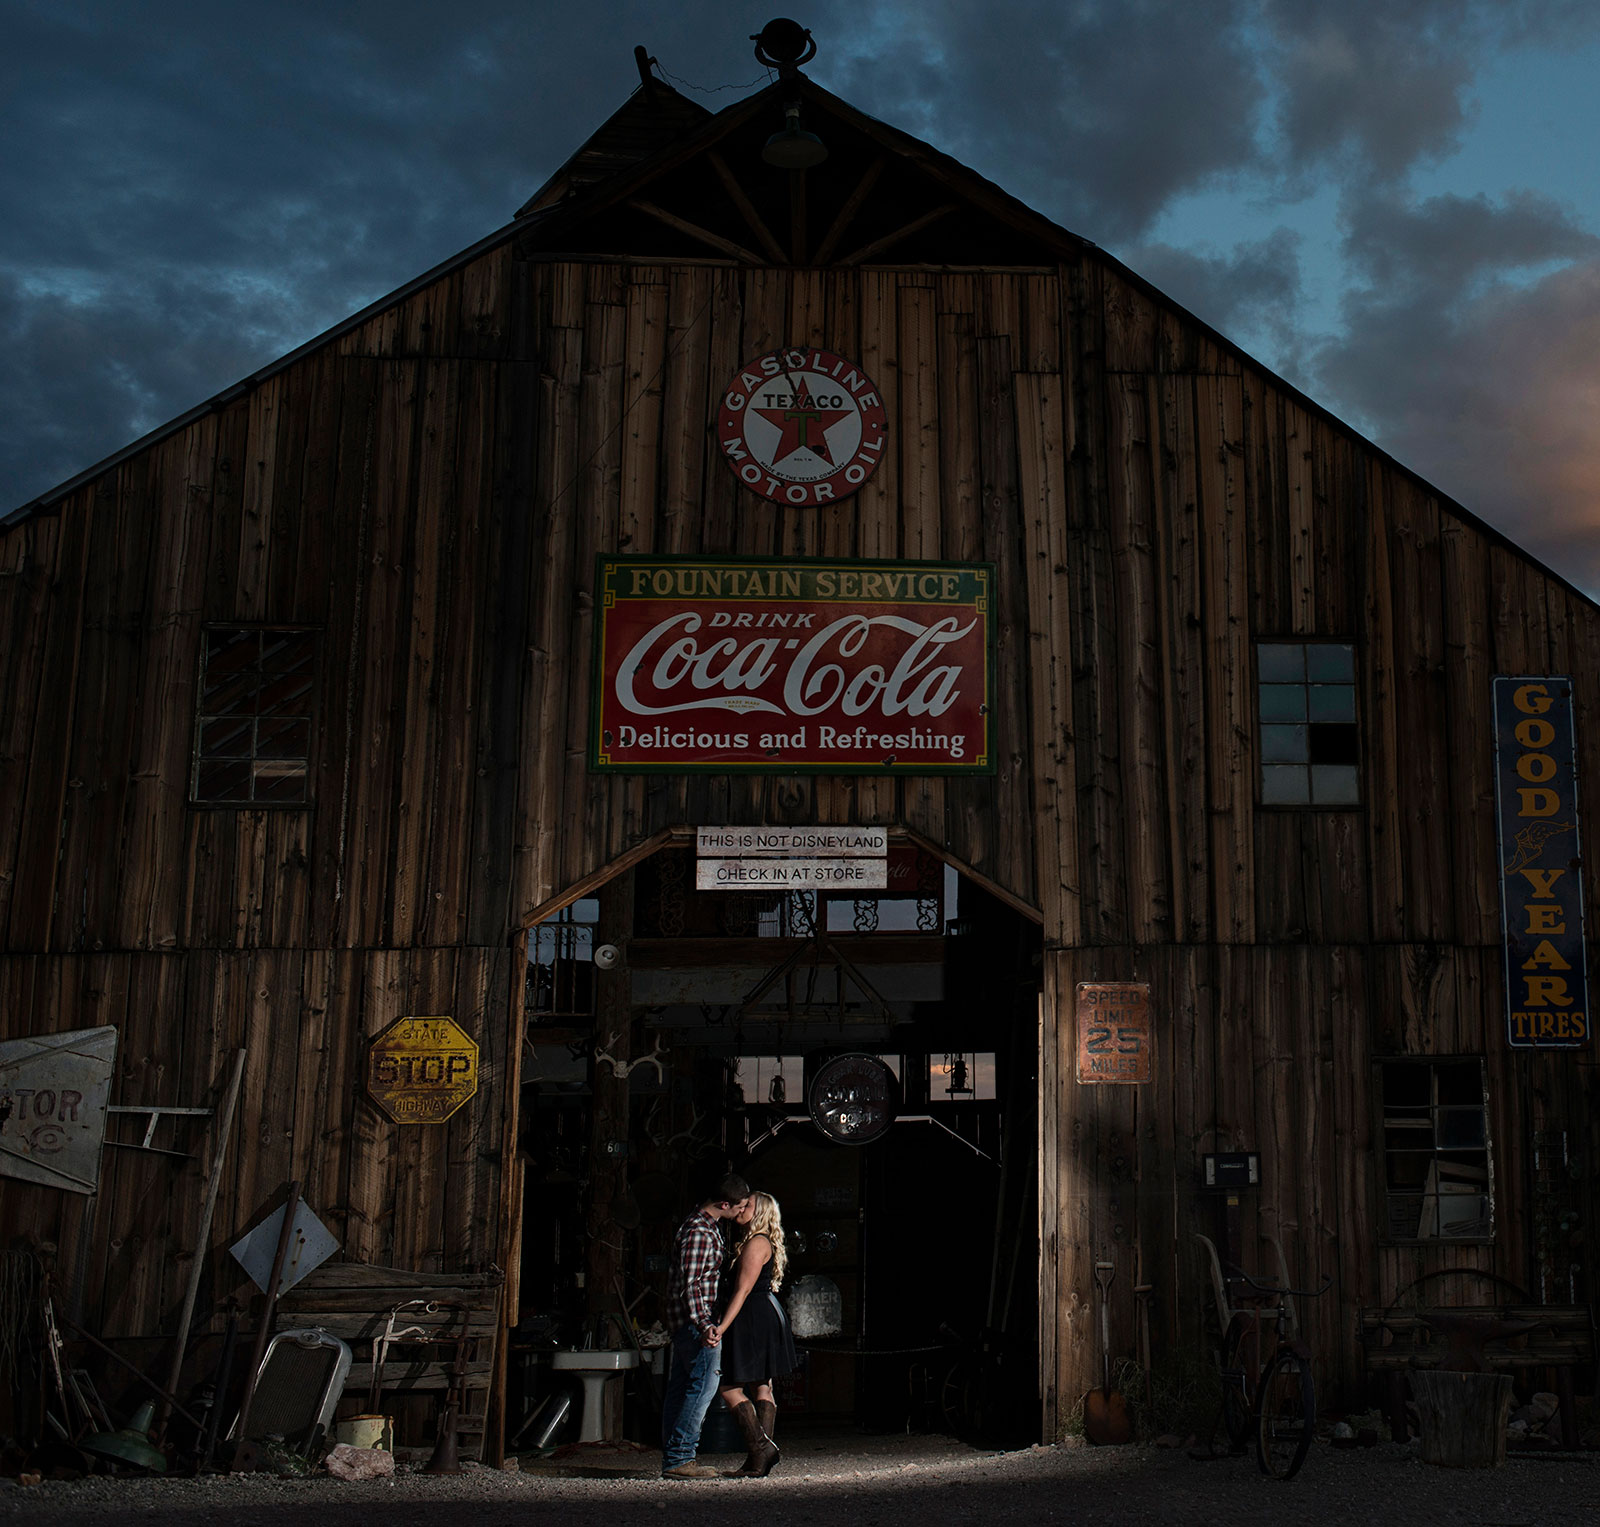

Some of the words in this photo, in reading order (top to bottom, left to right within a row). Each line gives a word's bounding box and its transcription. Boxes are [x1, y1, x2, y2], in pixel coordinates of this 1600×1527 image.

[725, 350, 880, 412] GASOLINE
[763, 393, 844, 410] TEXACO
[783, 411, 822, 447] T
[723, 437, 836, 504] MOTOR
[844, 436, 884, 485] OIL
[818, 462, 845, 479] COMPANY
[629, 569, 802, 596] FOUNTAIN
[815, 572, 961, 600] SERVICE
[708, 611, 817, 628] DRINK
[614, 611, 978, 718] Coca-Cola
[618, 724, 749, 749] Delicious
[758, 728, 807, 750] and
[818, 725, 966, 758] Refreshing
[699, 834, 734, 847] THIS
[739, 834, 752, 847] IS
[757, 834, 789, 848] NOT
[792, 835, 884, 849] DISNEYLAND
[716, 867, 768, 881] CHECK
[773, 867, 788, 881] IN
[791, 867, 810, 881] AT
[814, 867, 864, 881] STORE
[887, 862, 912, 880] ola
[1087, 990, 1140, 1006] SPEED
[1093, 1009, 1135, 1024] LIMIT
[1511, 1011, 1586, 1039] TIRES
[402, 1028, 449, 1041] STATE
[1087, 1027, 1141, 1054] 25
[376, 1055, 471, 1084] STOP
[1091, 1058, 1137, 1073] MILES
[1, 1088, 83, 1122] TOR
[393, 1098, 451, 1113] HIGHWAY
